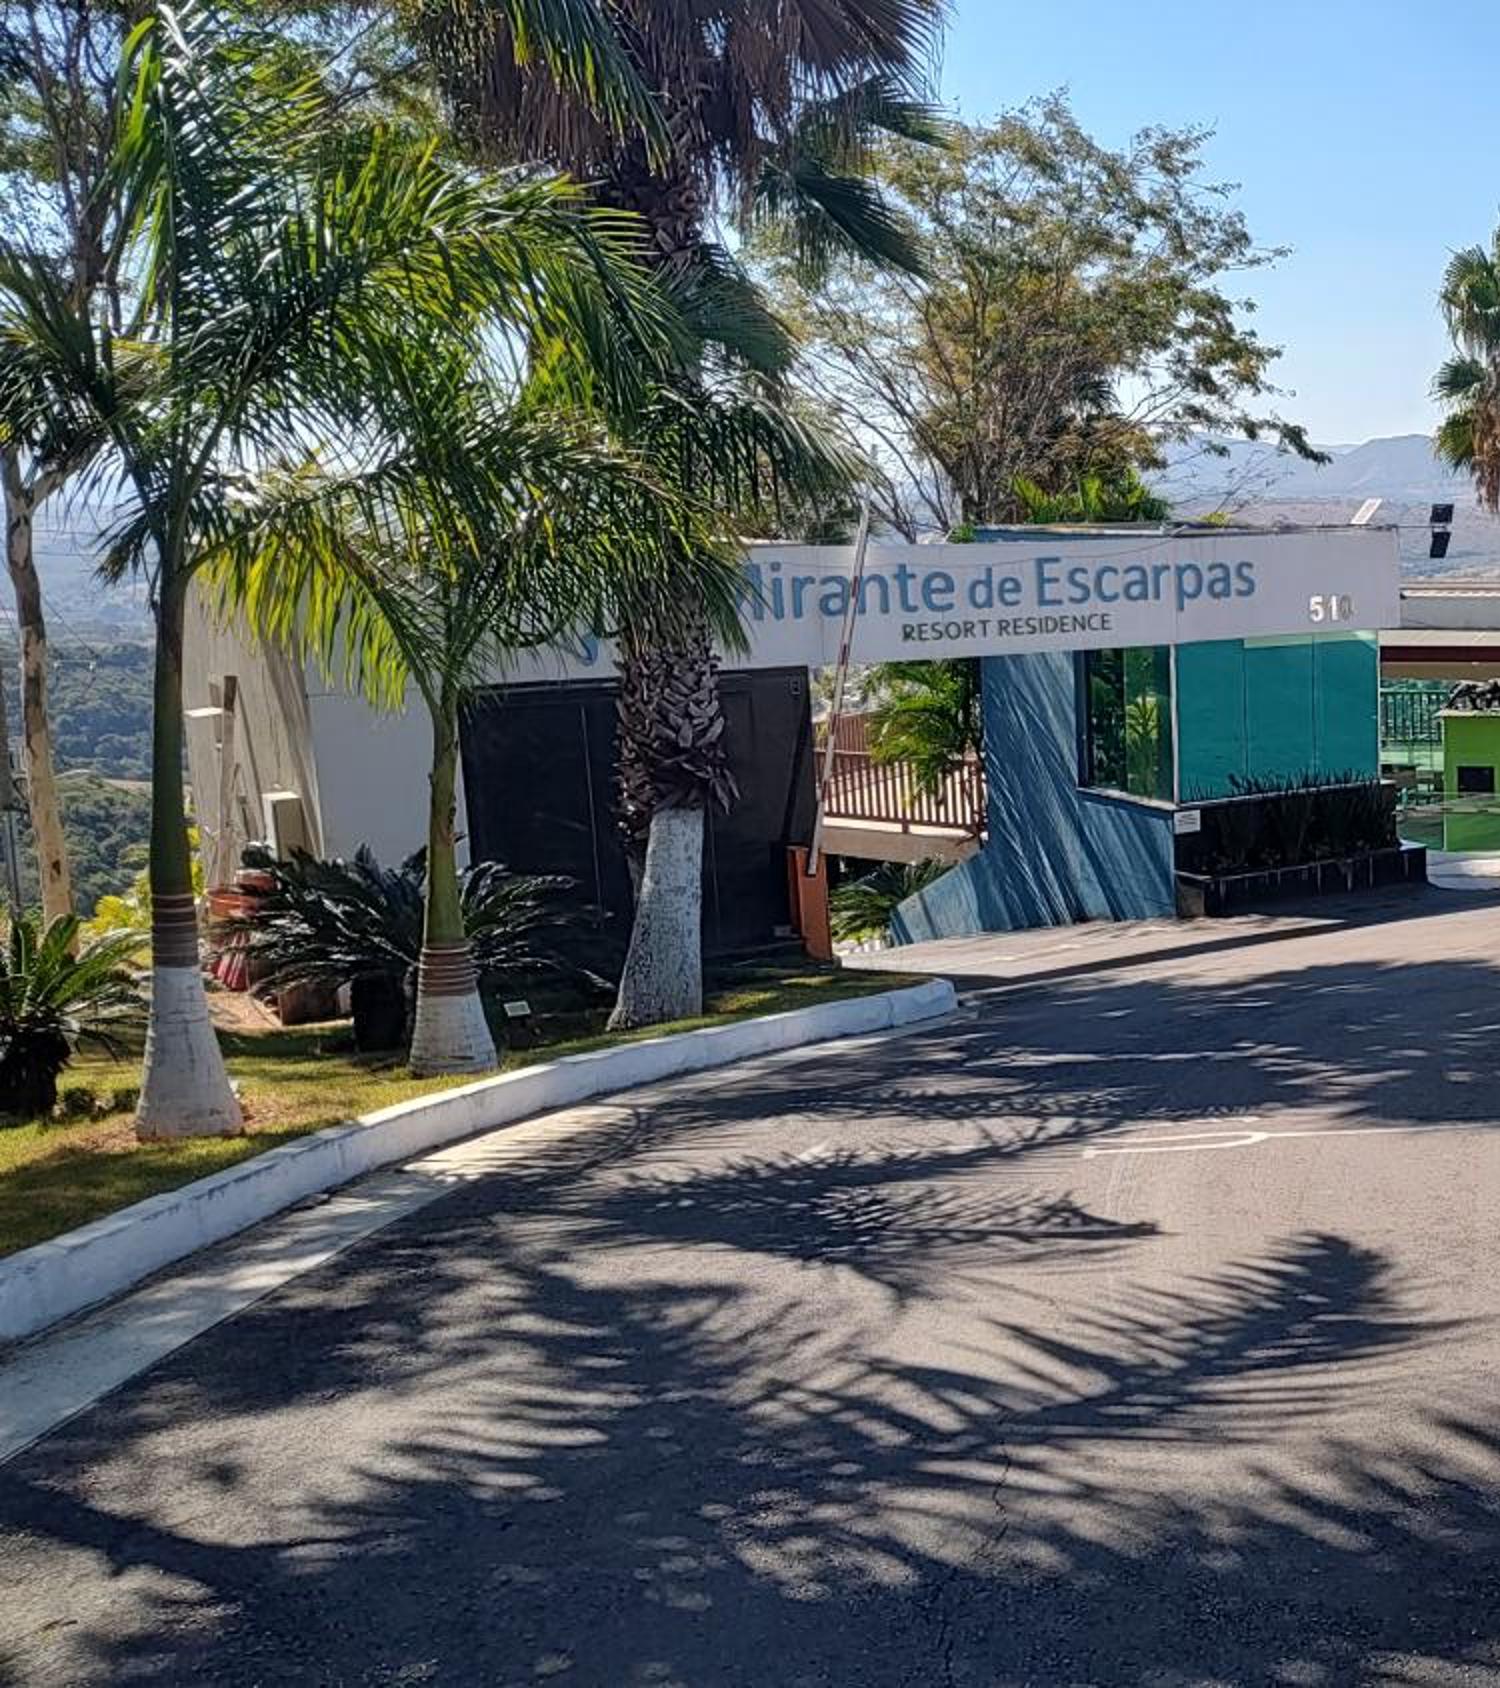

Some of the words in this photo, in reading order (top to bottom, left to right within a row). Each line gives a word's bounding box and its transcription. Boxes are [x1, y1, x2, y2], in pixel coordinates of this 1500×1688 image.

[967, 567, 1023, 609] de
[1034, 556, 1257, 612] Escarpas
[1309, 594, 1353, 622] 510
[902, 619, 991, 642] RESORT
[999, 613, 1113, 637] RESIDENCE
